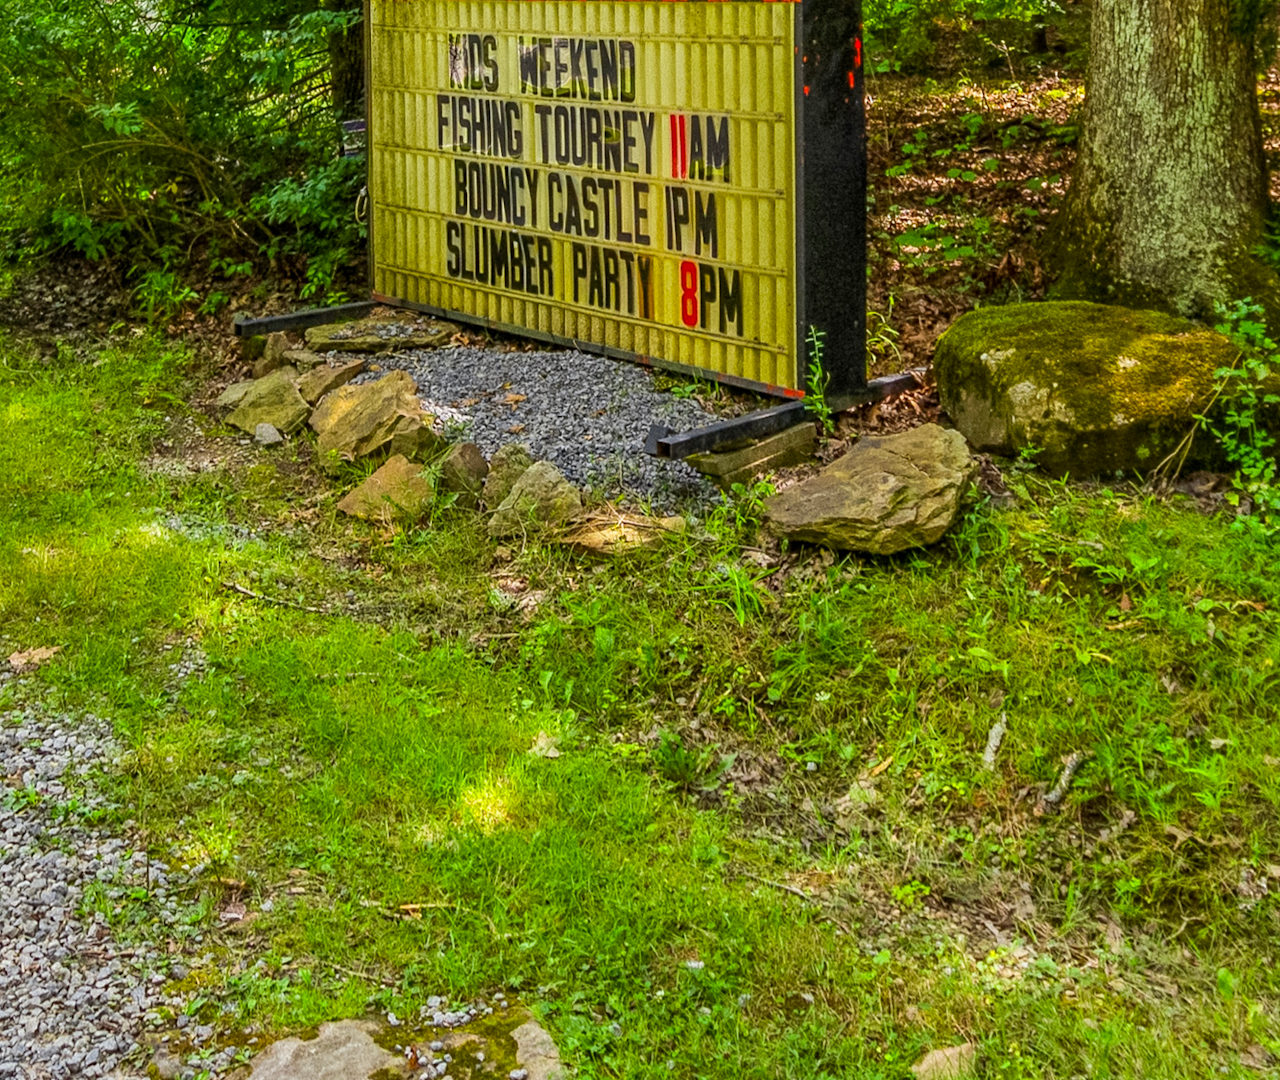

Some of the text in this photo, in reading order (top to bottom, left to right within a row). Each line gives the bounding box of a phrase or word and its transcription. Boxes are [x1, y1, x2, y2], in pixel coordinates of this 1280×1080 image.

[449, 34, 636, 103] KIDS WEEKEND
[437, 94, 523, 158] FISHING
[535, 104, 655, 175] TOURNEY
[455, 159, 718, 258] BOUNCY CASTLE 1PM
[446, 221, 744, 337] SLUMBER PARTY 8PM
